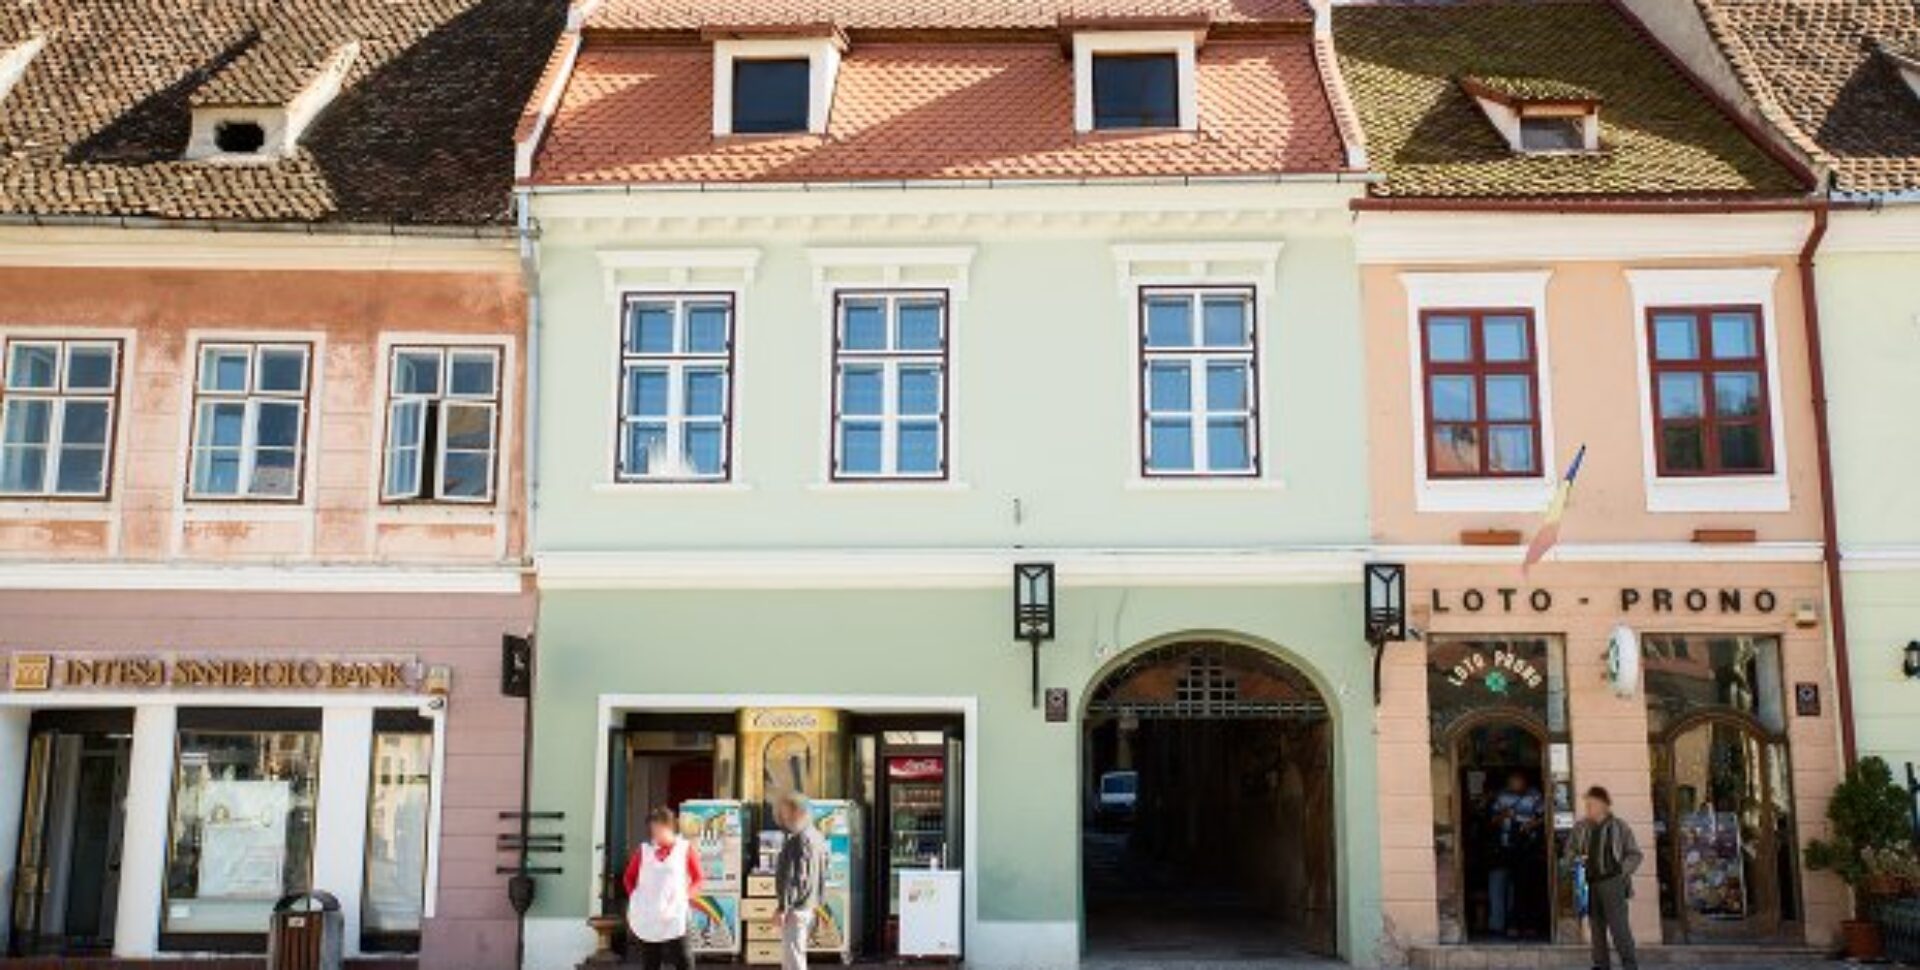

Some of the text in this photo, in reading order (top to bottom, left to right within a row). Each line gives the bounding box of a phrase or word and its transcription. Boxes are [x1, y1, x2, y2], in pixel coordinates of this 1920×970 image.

[1432, 588, 1552, 613] LOTO
[1621, 588, 1777, 613] PRONO
[325, 659, 408, 688] BANK
[1448, 650, 1542, 688] LOTO PRONO
